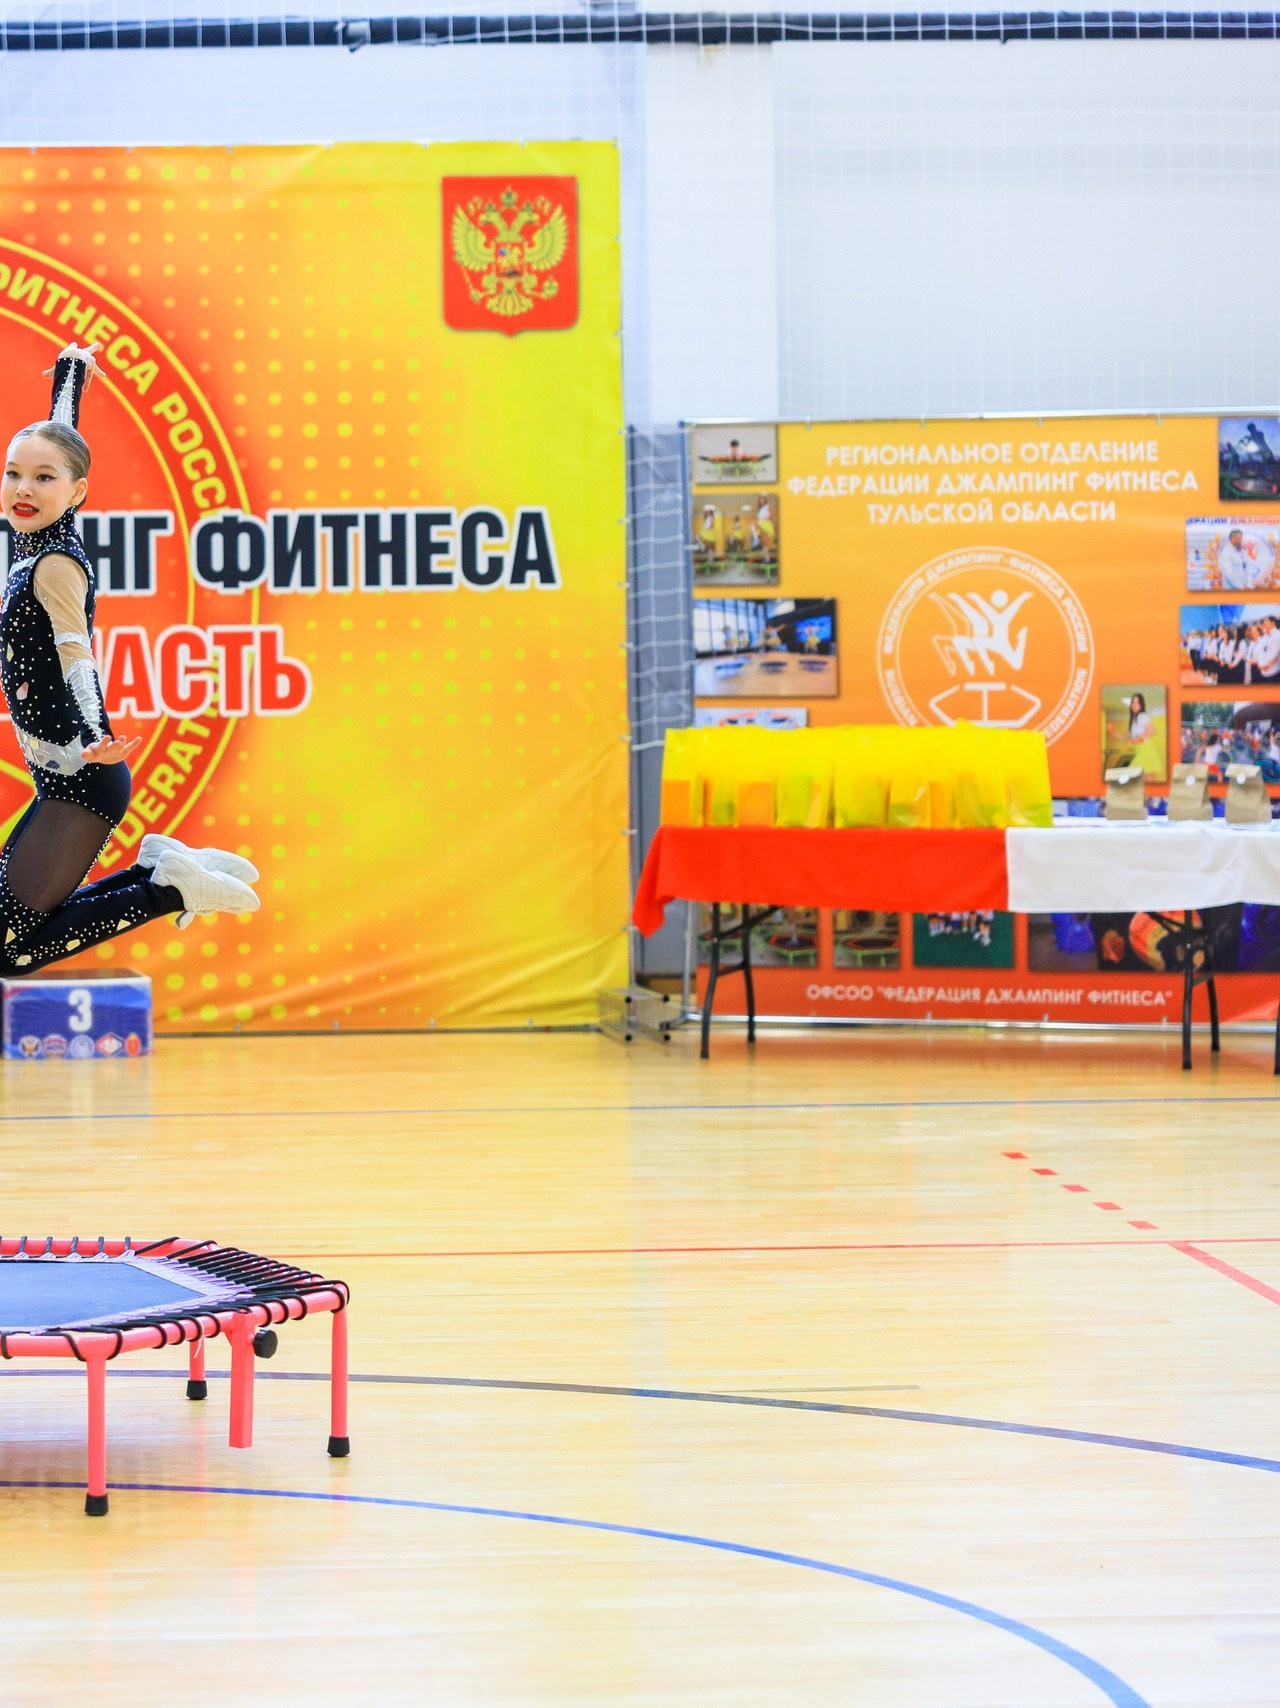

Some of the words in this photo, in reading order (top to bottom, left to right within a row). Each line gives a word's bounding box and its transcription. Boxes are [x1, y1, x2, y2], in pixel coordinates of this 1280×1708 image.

[151, 391, 231, 516] РОСС
[825, 442, 1014, 467] РЕГИОНАЛЬНОЕ
[1019, 440, 1159, 465] ОТДЕЛЕНИЕ
[786, 472, 927, 499] ФЕДЕРАЦИИ
[935, 471, 1081, 498] ДЖАМПИНГ
[1085, 469, 1200, 493] ФИТНЕСА
[867, 497, 994, 525] ТУЛЬСКОЙ
[1001, 500, 1117, 523] ОБЛАСТИ
[194, 509, 558, 590] ФИТНЕСА
[1043, 667, 1088, 739] EDERATION
[68, 988, 93, 1032] 3
[806, 984, 874, 1001] ОФСОО
[985, 987, 1082, 1006] ДЖАМПИНГ
[1087, 990, 1173, 1007] ФИТНЕСА"
